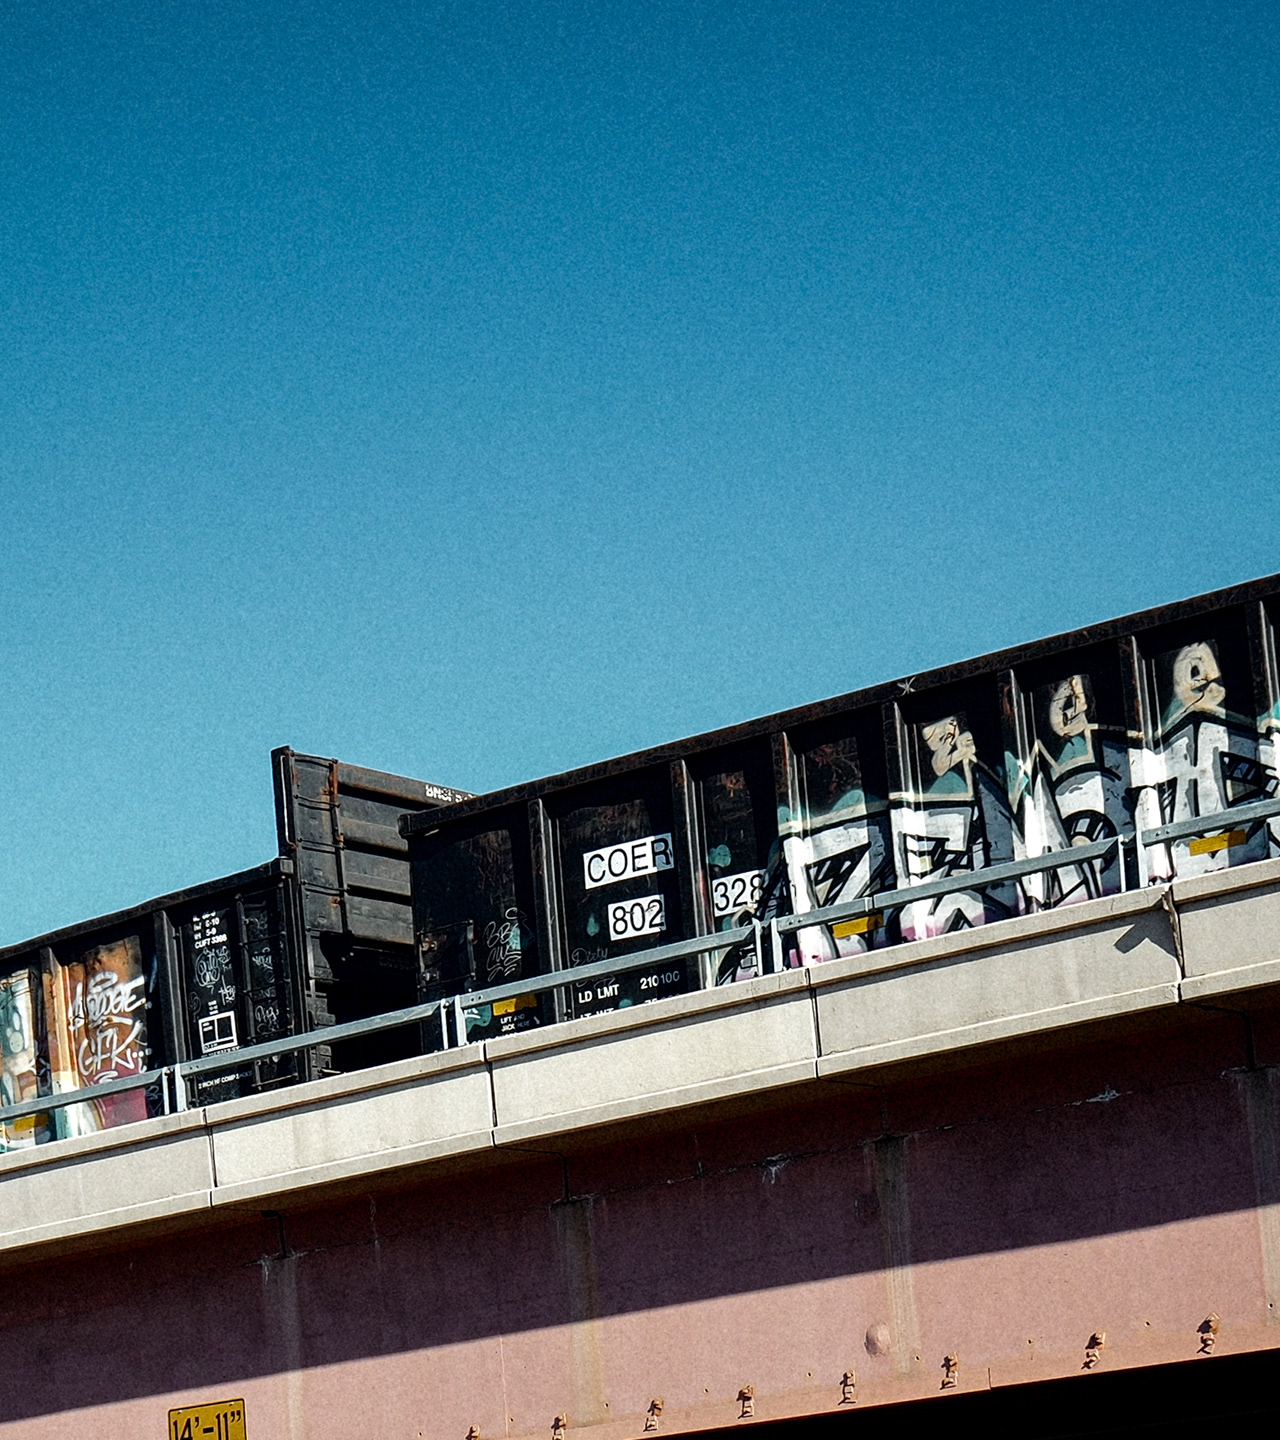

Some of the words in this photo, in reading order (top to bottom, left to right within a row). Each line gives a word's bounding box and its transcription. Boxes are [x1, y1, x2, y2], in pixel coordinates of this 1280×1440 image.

[587, 837, 672, 883] COER
[612, 899, 665, 935] 802
[578, 990, 593, 1004] LD
[597, 984, 620, 999] LMT
[500, 1015, 513, 1025] LIFT
